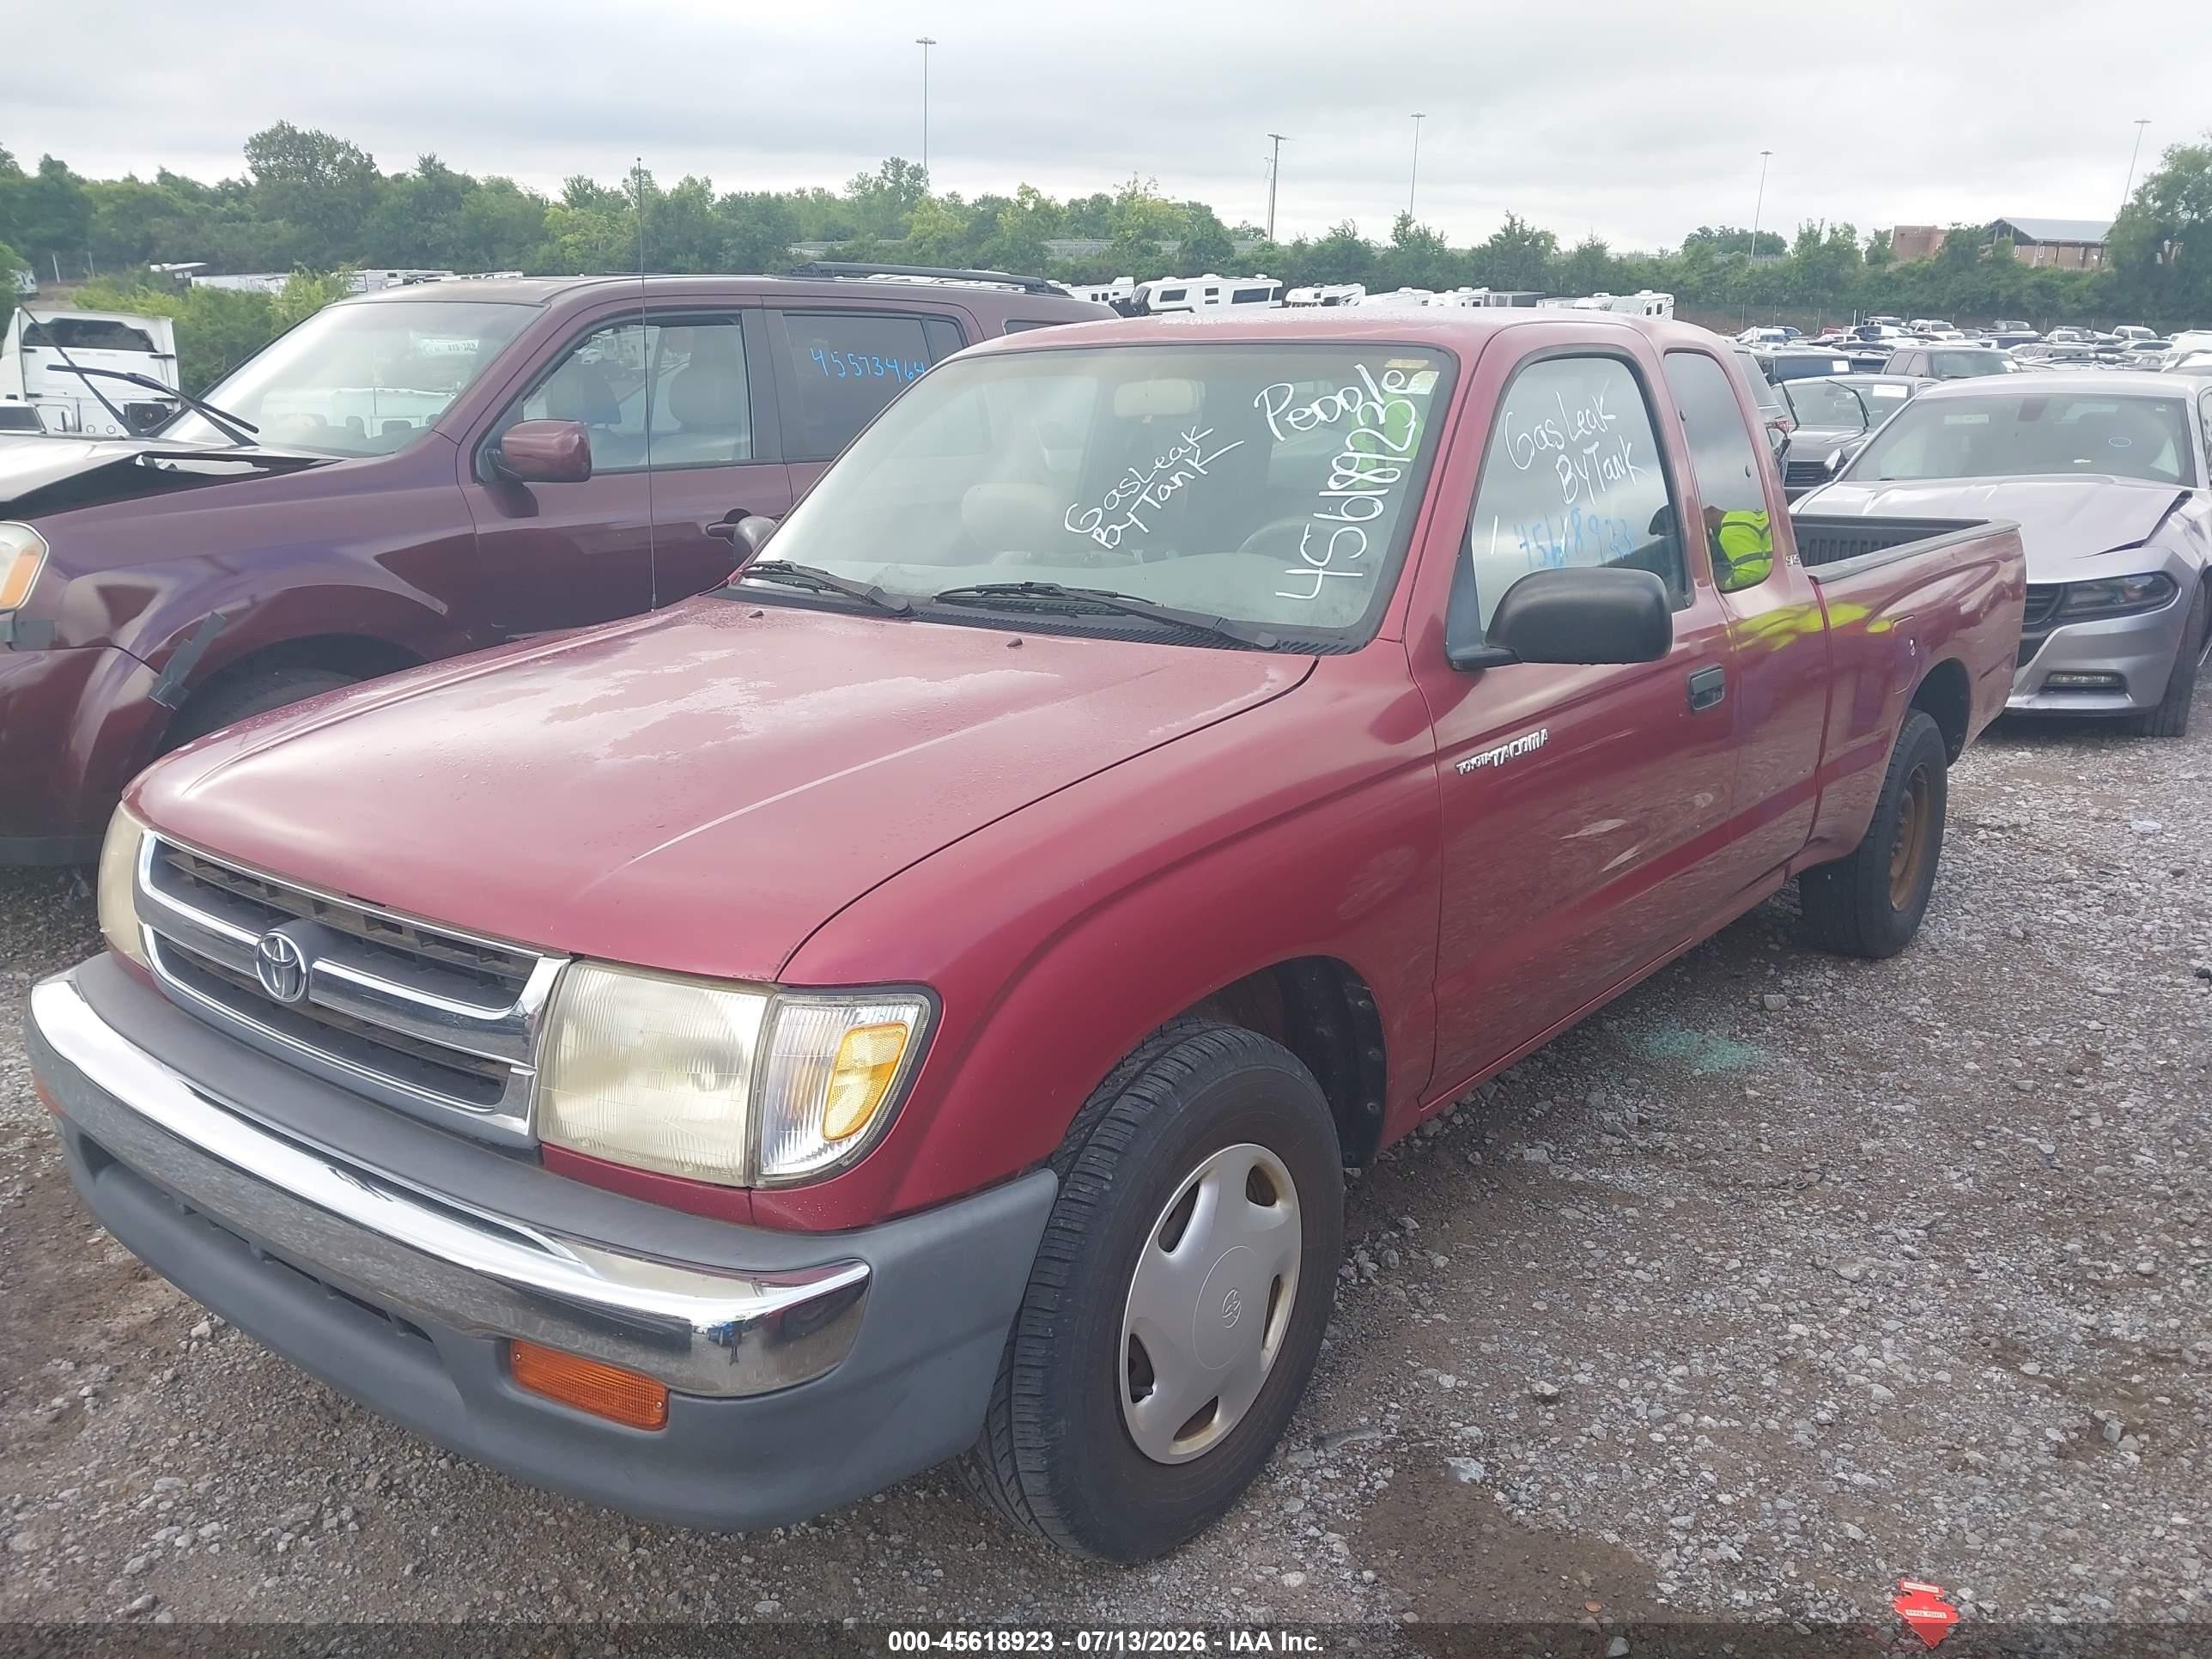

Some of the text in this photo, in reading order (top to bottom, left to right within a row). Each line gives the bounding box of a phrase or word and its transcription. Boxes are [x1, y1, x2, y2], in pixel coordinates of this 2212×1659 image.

[1504, 411, 1565, 471] Gas
[1273, 399, 1418, 600] 45618923
[1555, 453, 1596, 506] By
[1455, 728, 1548, 775] TOYOTA TACOMA
